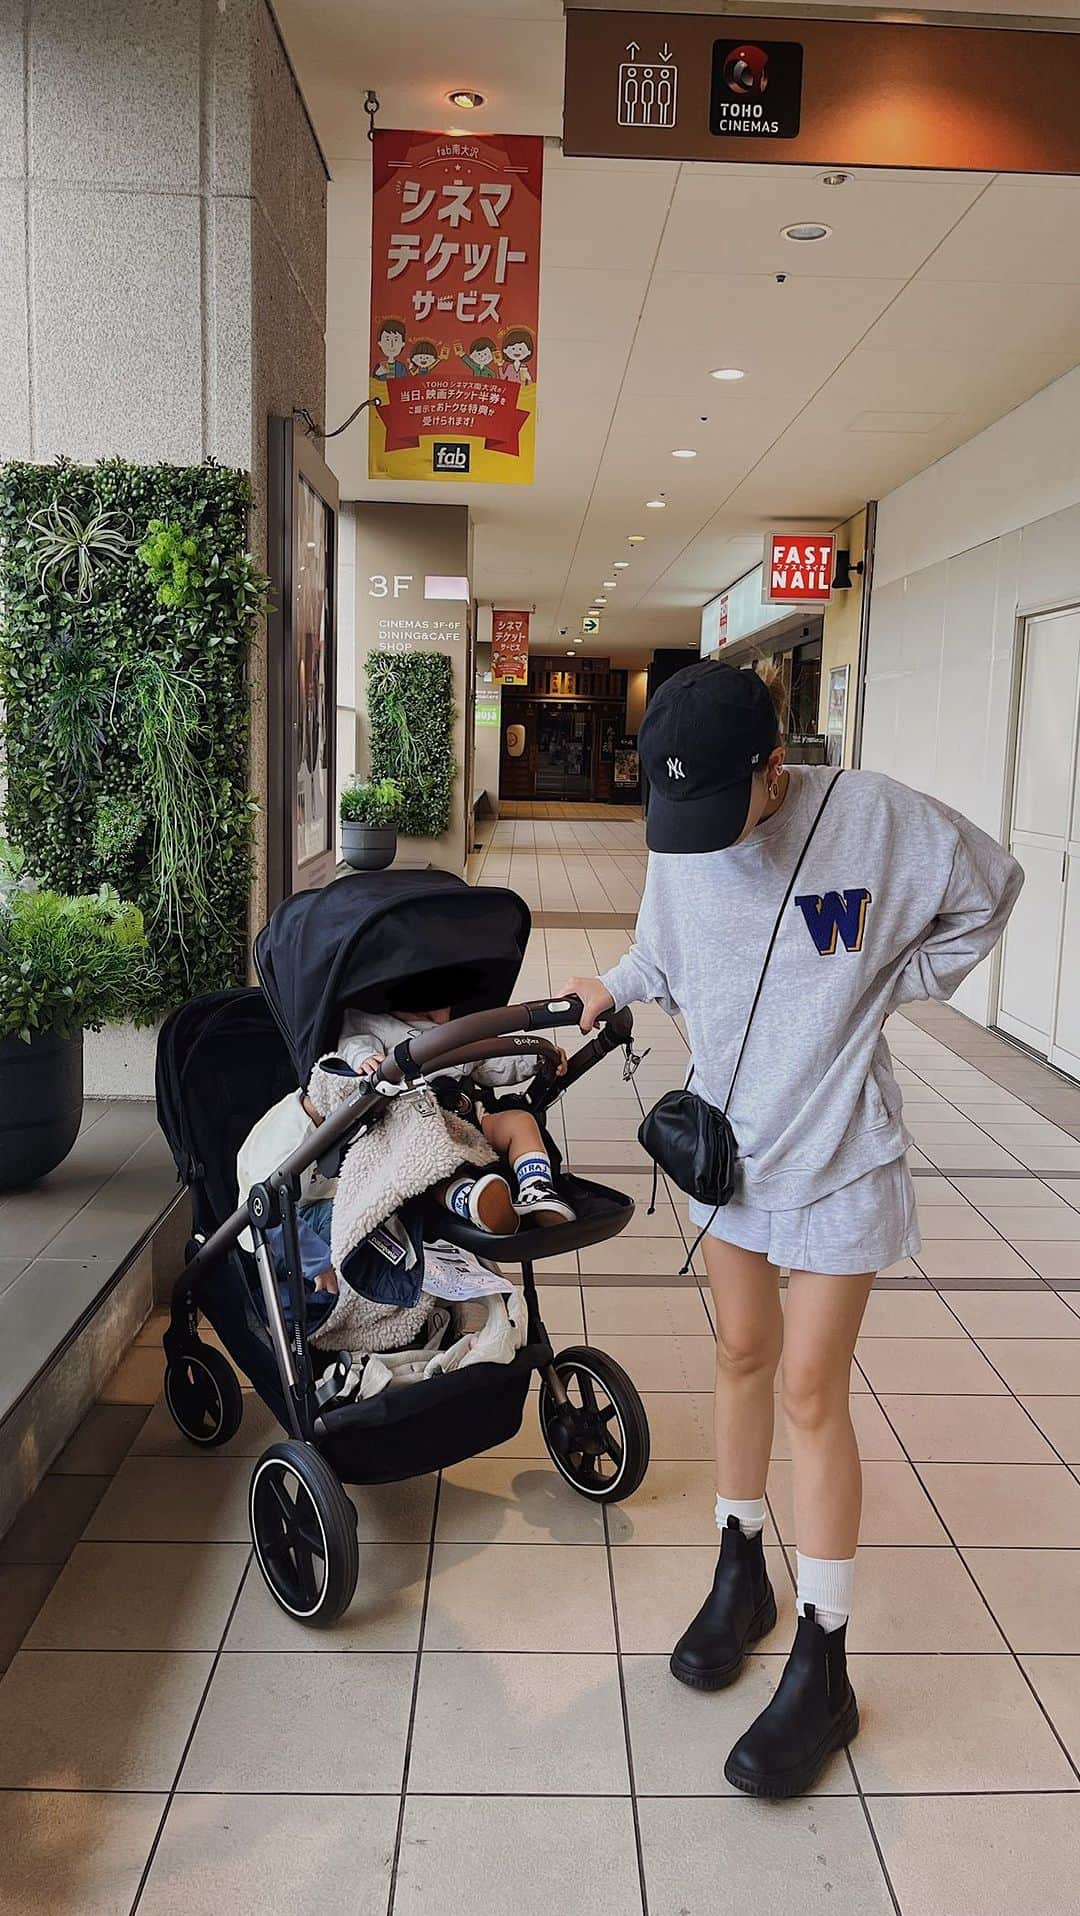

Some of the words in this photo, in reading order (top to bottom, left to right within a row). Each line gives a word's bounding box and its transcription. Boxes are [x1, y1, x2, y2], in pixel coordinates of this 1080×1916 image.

[720, 103, 763, 118] TOHO
[719, 120, 779, 133] CINEMAS
[400, 179, 512, 228] シネマ
[386, 234, 527, 284] チケット
[411, 289, 502, 324] サービス
[426, 381, 448, 389] TOHO
[436, 447, 467, 466] fab
[773, 545, 831, 565] FAST
[775, 563, 826, 571] ファストネイル
[367, 575, 414, 599] 3F
[771, 571, 830, 591] NAIL
[378, 619, 429, 629] CINEMAS
[378, 631, 461, 641] DINING&CAFE
[378, 642, 413, 651] SHOP
[666, 756, 686, 780] NY
[794, 887, 873, 956] W
